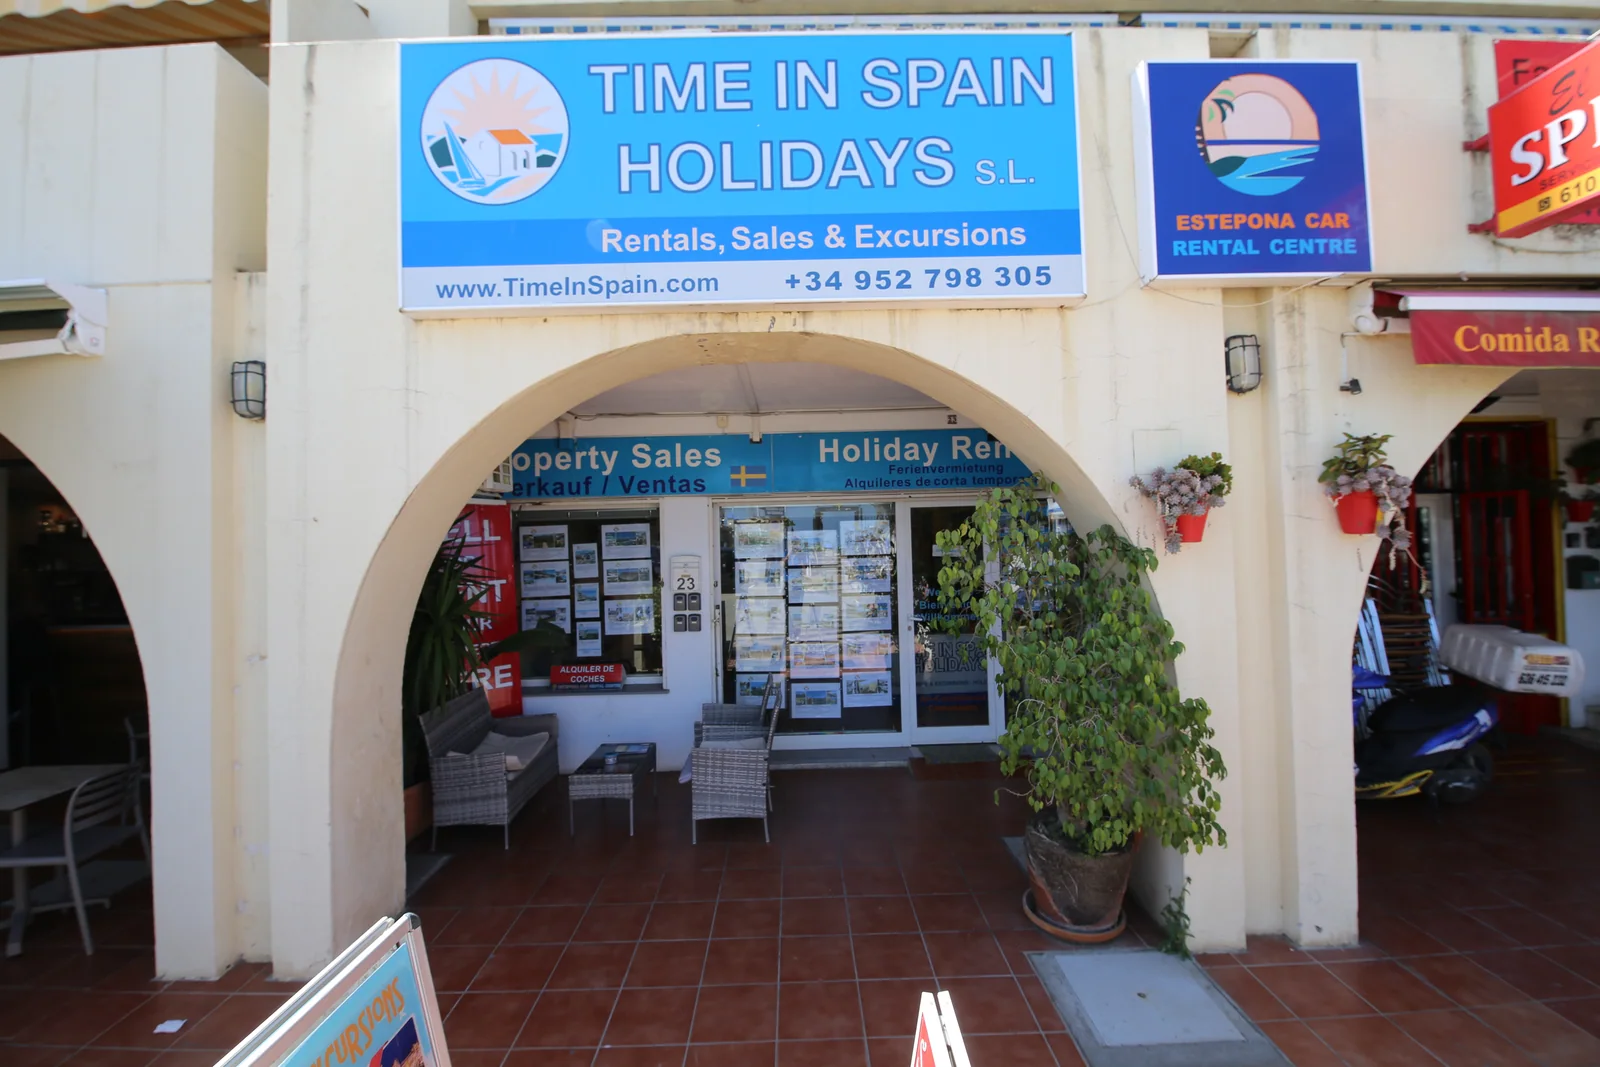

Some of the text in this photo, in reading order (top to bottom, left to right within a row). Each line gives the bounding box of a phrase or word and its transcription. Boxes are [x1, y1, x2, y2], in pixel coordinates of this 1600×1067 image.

[588, 56, 1056, 114] TIME IN SPAIN
[617, 135, 1037, 194] HOLIDAYS S.L.
[1560, 176, 1597, 203] 610
[1176, 212, 1350, 231] ESTEPONA CAR
[600, 222, 1027, 255] Rentals, Sales & Excursions
[1172, 238, 1358, 256] RENTAL CENTRE
[435, 272, 720, 300] www.TimeInSpain.com
[785, 265, 1053, 292] +34 952 798 305
[1453, 325, 1570, 352] Comida
[631, 443, 722, 469] Sales
[818, 437, 939, 467] Holiday
[888, 462, 1004, 476] Ferienvermietung
[601, 475, 609, 496] /
[618, 475, 707, 495] Ventas
[844, 477, 911, 490] Alquileres
[916, 477, 931, 487] de
[934, 476, 967, 487] corta
[676, 577, 696, 590] 23
[559, 665, 615, 674] ALQUILER DE
[570, 674, 605, 683] COCHES
